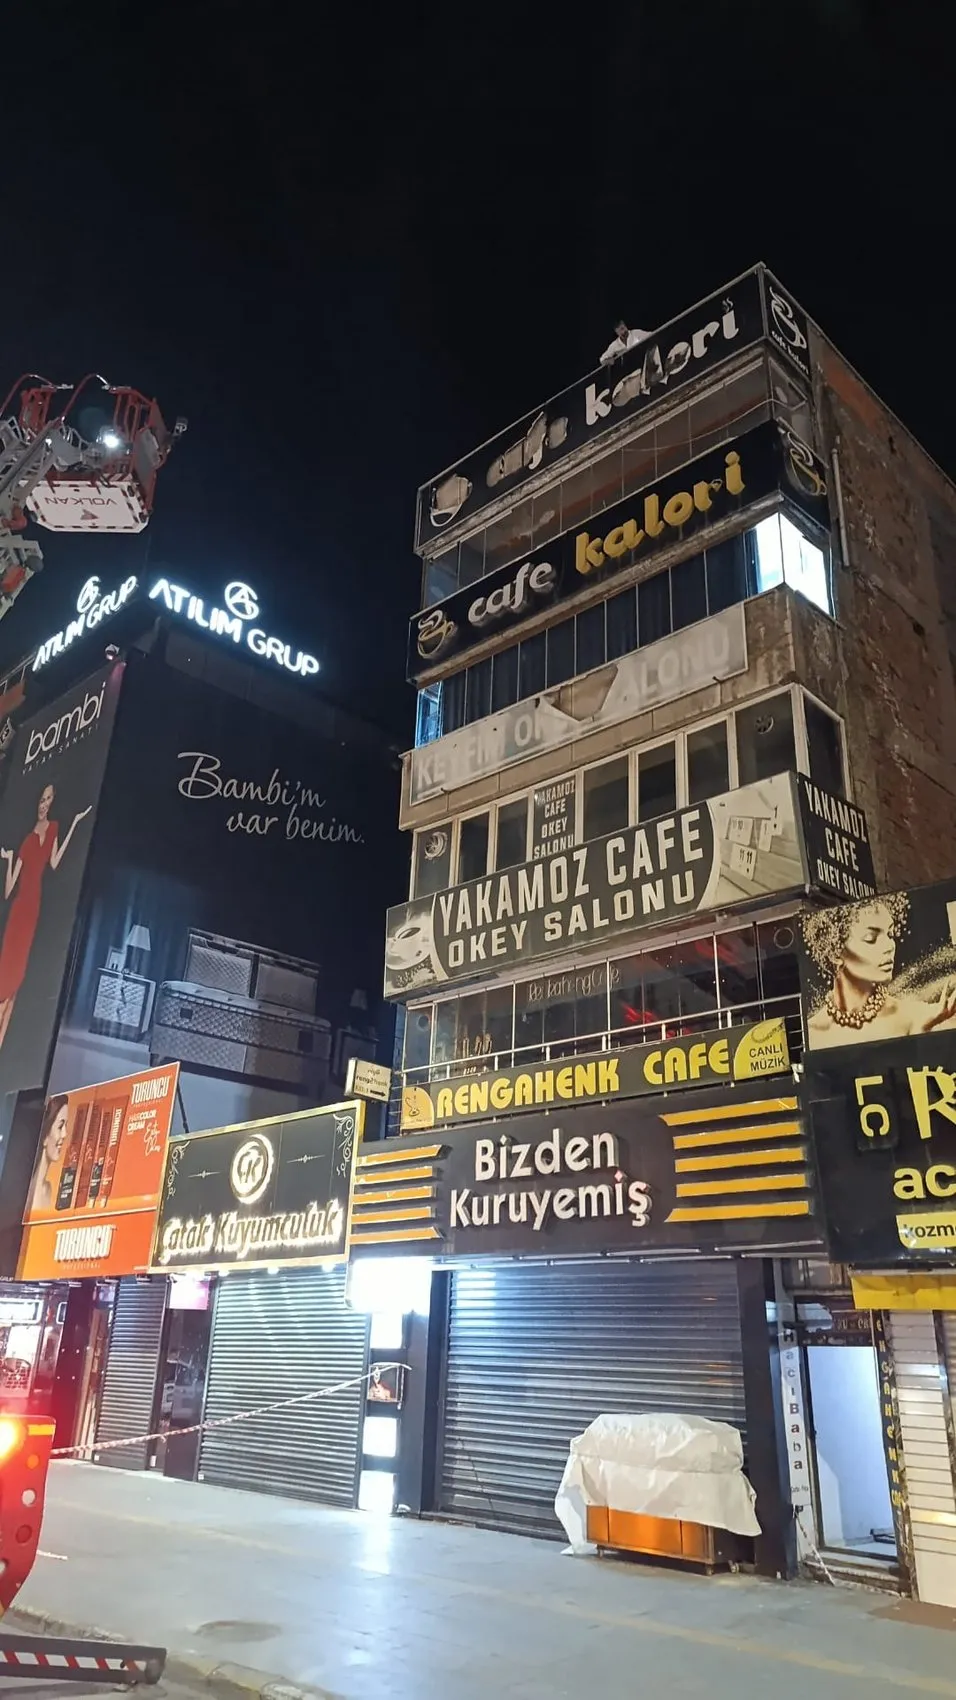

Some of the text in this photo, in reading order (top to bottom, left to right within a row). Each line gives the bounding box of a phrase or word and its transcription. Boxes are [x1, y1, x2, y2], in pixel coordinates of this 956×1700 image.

[44, 497, 118, 506] VOLKAN
[468, 451, 745, 626] cafe kalori
[32, 576, 137, 672] ATILIM GRUP
[149, 578, 320, 676] ATILIM GRUP
[607, 627, 730, 712] ALONU
[25, 681, 106, 765] bambi
[178, 751, 326, 808] Bambi'm
[544, 798, 567, 818] CAFE
[226, 803, 365, 844] var benim.
[541, 816, 568, 839] OKEY
[804, 780, 867, 843] YAKAMOZ
[439, 809, 704, 937] YAKAMOZ CAFE
[533, 834, 574, 860] SALONU
[817, 858, 840, 890] OKEY
[825, 827, 859, 872] CAFE
[448, 870, 696, 968] OKEY SALONU
[435, 1037, 731, 1119] RENGAHENK CAFE
[749, 1043, 783, 1058] CANLI
[750, 1056, 786, 1071] MÜZİK
[131, 1076, 170, 1104] TURUNCU
[906, 1066, 956, 1139] R
[475, 1127, 618, 1181] Bizden
[214, 1199, 342, 1259] Kuyumculuk
[450, 1170, 652, 1231] Kuruyemiş
[54, 1224, 114, 1261] TURUNCU
[789, 1403, 803, 1470] Baba
